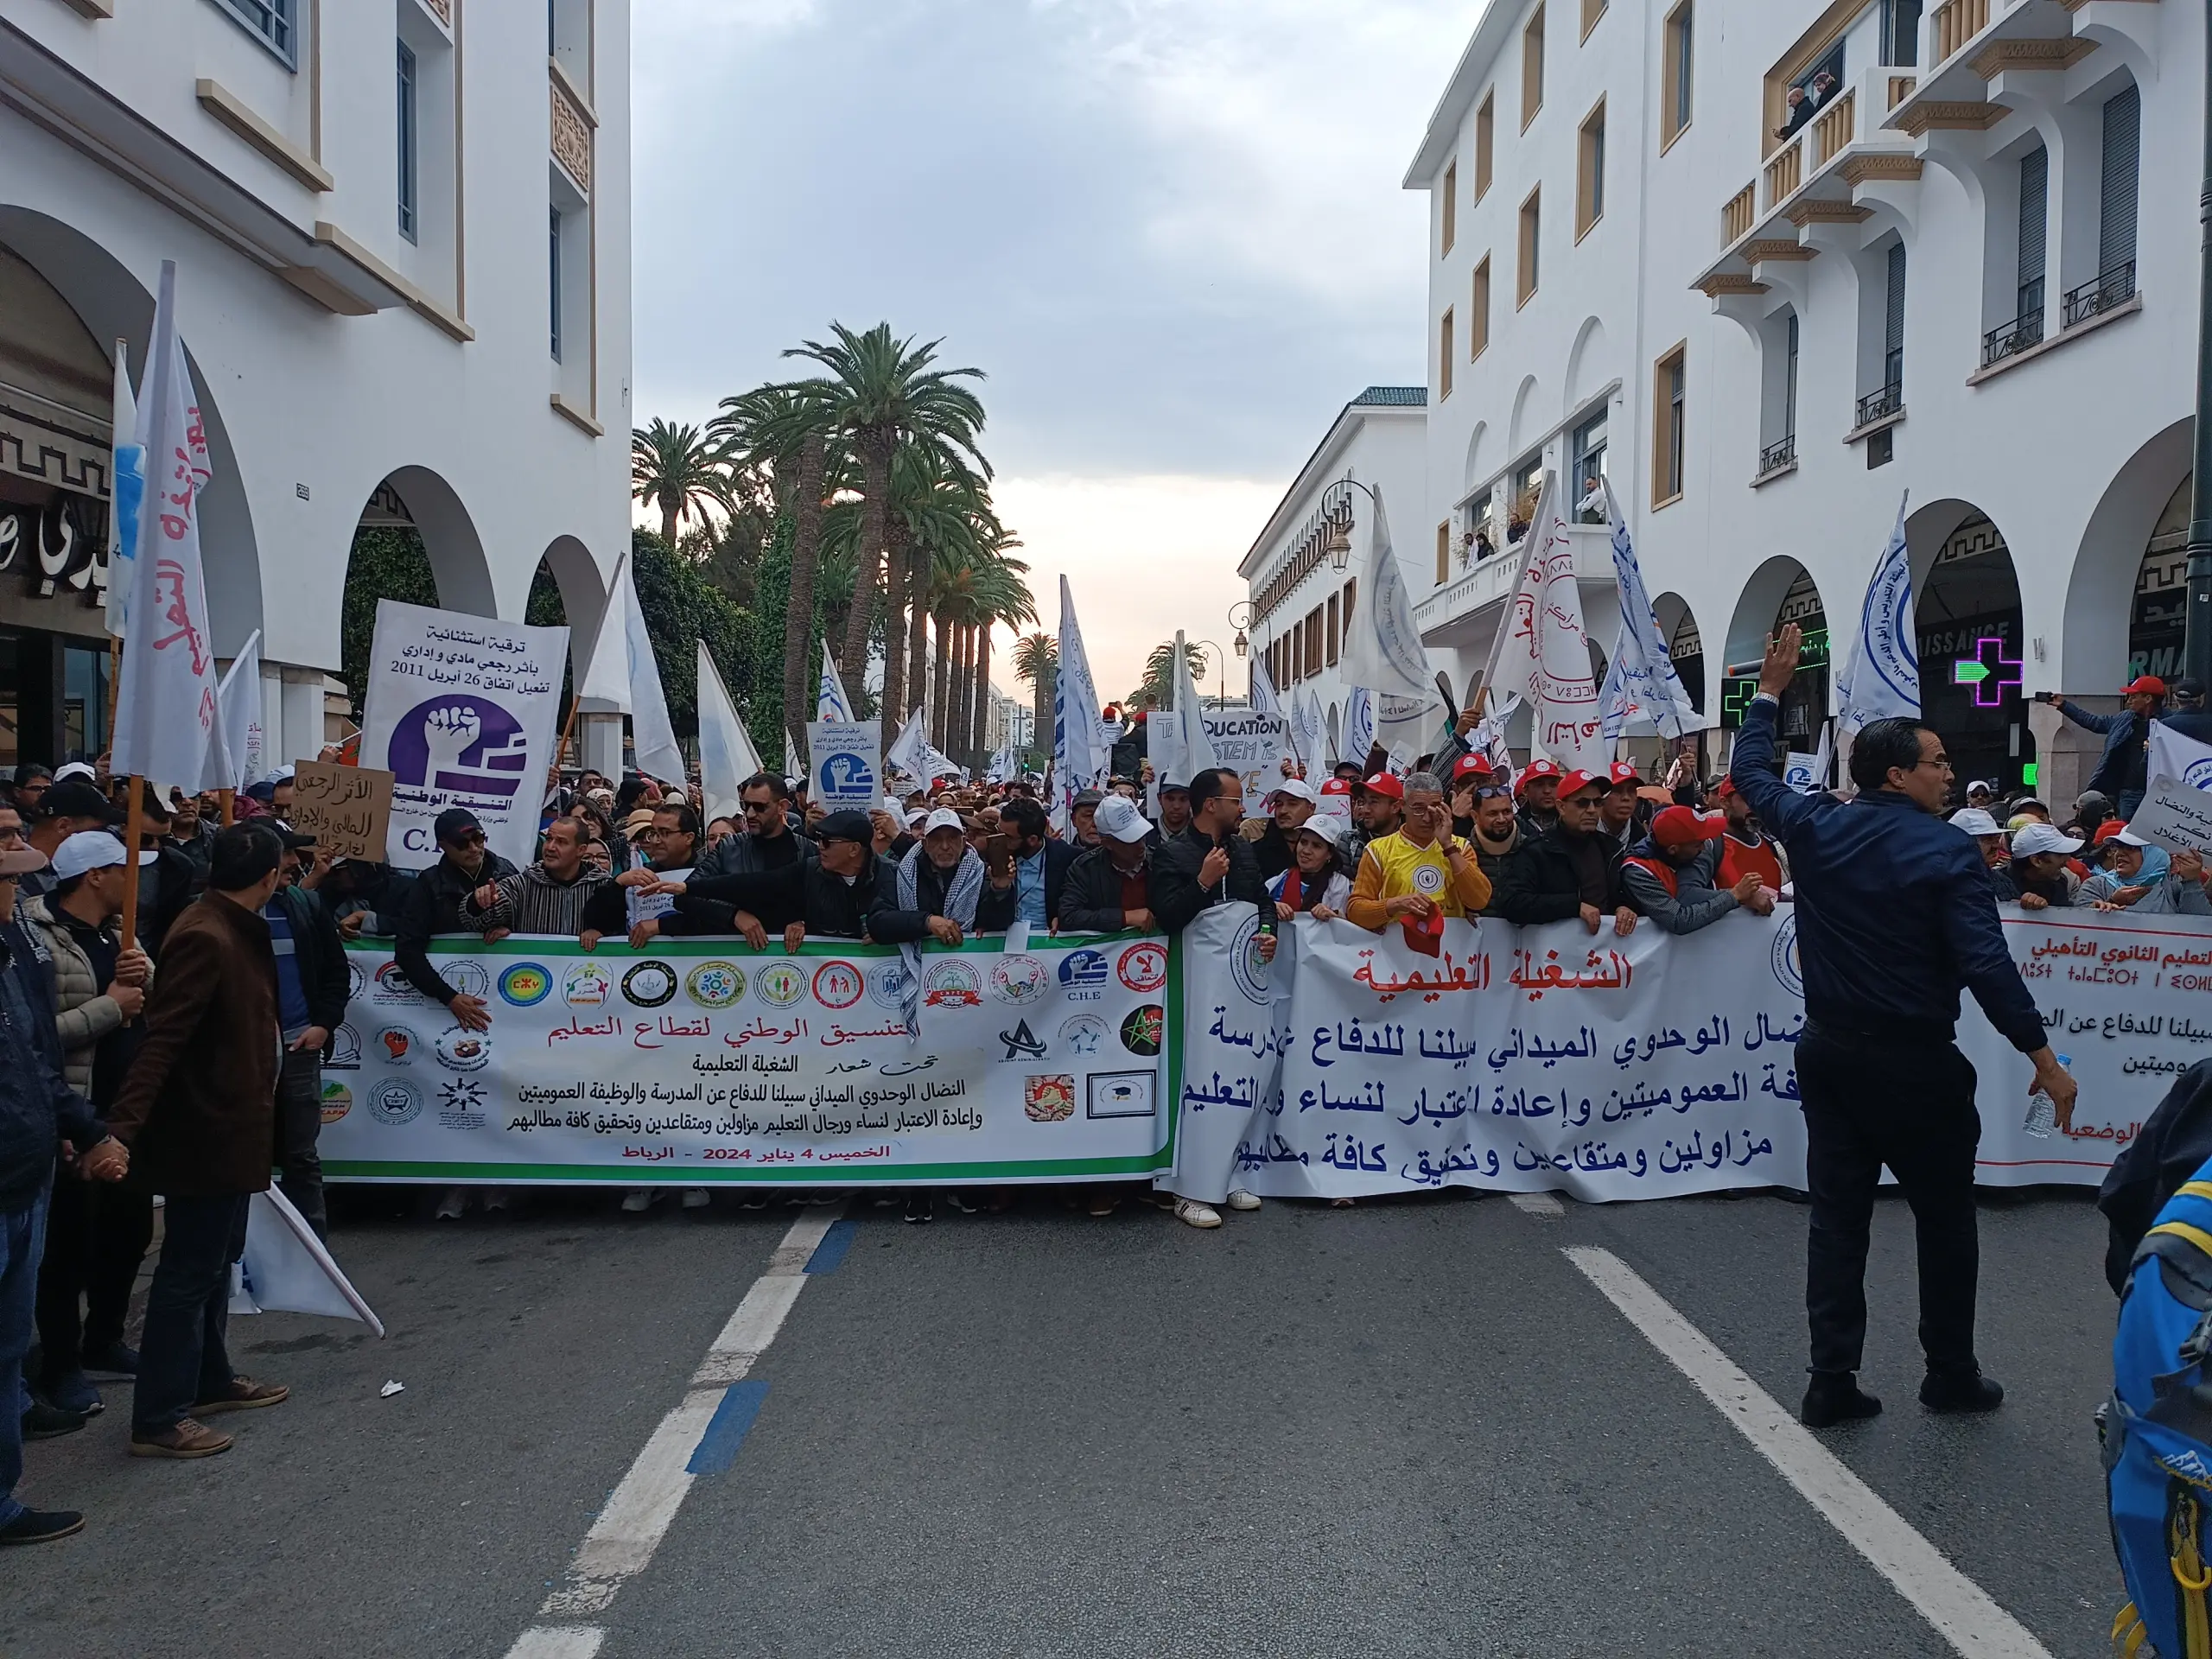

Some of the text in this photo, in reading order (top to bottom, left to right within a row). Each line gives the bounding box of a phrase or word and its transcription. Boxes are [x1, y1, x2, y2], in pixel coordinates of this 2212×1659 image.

[426, 626, 526, 654] ترقية استثنائية
[446, 651, 474, 664] مادي
[477, 660, 512, 674] رجعي
[513, 659, 539, 677] بأثر
[391, 660, 550, 696] تفعيل اتفاق 26 أبريل 2011
[391, 786, 512, 811] التنسيقية الوطنية
[2031, 936, 2212, 970] لتعليم الثانوي التأهيلي
[1352, 947, 1633, 1003] الشغيلة التعليمية
[1067, 991, 1101, 1001] C.H.E
[548, 1015, 921, 1049] اتنسيق الوطني لقطاع التعليم
[2069, 1016, 2098, 1034] عن
[2102, 1013, 2163, 1039] للدفاع
[1311, 1016, 1406, 1068] للدفاع
[1487, 1024, 1598, 1074] الميداني
[1612, 1013, 1730, 1071] الوحدوي
[692, 1053, 939, 1077] تحت شعار الشغيلة التعليمية
[518, 1078, 966, 1112] النضال الوحدوي الميداني سبيلنا للدفاع عن المدرسة والوظيفة العموميتين
[1298, 1080, 1385, 1115] لنساء
[1491, 1084, 1592, 1129] وإعادة
[1601, 1069, 1749, 1122] العموميتين
[506, 1109, 562, 1133] مطالبهم
[565, 1110, 591, 1128] كافة
[594, 1113, 642, 1135] وتحقيق
[645, 1112, 712, 1135] ومتقاعدين
[715, 1112, 760, 1136] مزاولين
[763, 1114, 809, 1136] التعليم
[812, 1114, 852, 1135] ورجال
[856, 1111, 889, 1129] لنساء
[893, 1109, 939, 1134] الاعتبار
[942, 1107, 983, 1131] وإعادة
[621, 1146, 675, 1161] الرباط
[702, 1148, 753, 1160] 2024
[756, 1147, 795, 1163] يناير
[800, 1148, 813, 1160] 4
[818, 1145, 891, 1161] الخميس
[1320, 1130, 1388, 1173] كافة
[1658, 1128, 1773, 1174] مزاولين
